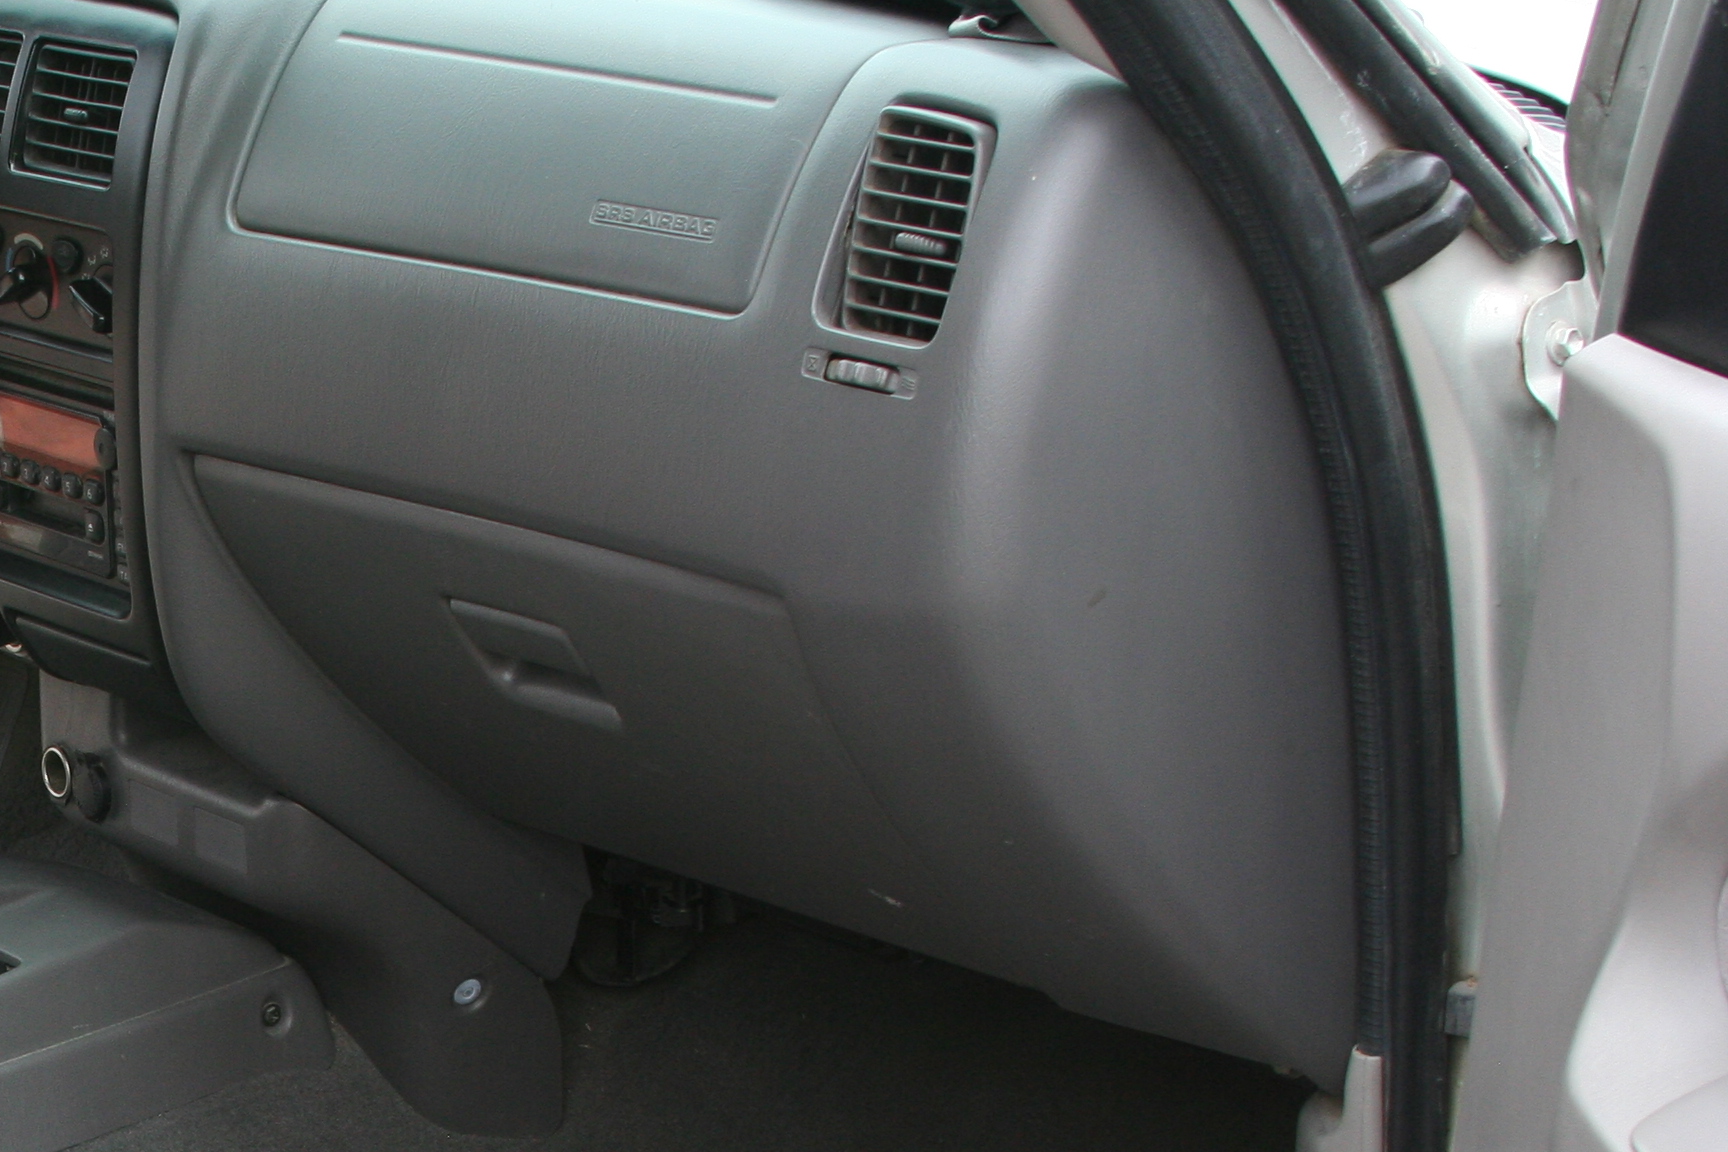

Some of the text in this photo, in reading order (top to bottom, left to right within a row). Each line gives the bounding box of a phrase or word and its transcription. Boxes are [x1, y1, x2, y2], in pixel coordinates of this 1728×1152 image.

[595, 202, 716, 236] SRS AIRBAG
[3, 461, 8, 472] 2
[23, 468, 29, 480] 3
[44, 475, 50, 486] 4
[65, 481, 71, 492] 5
[87, 488, 93, 499] 6
